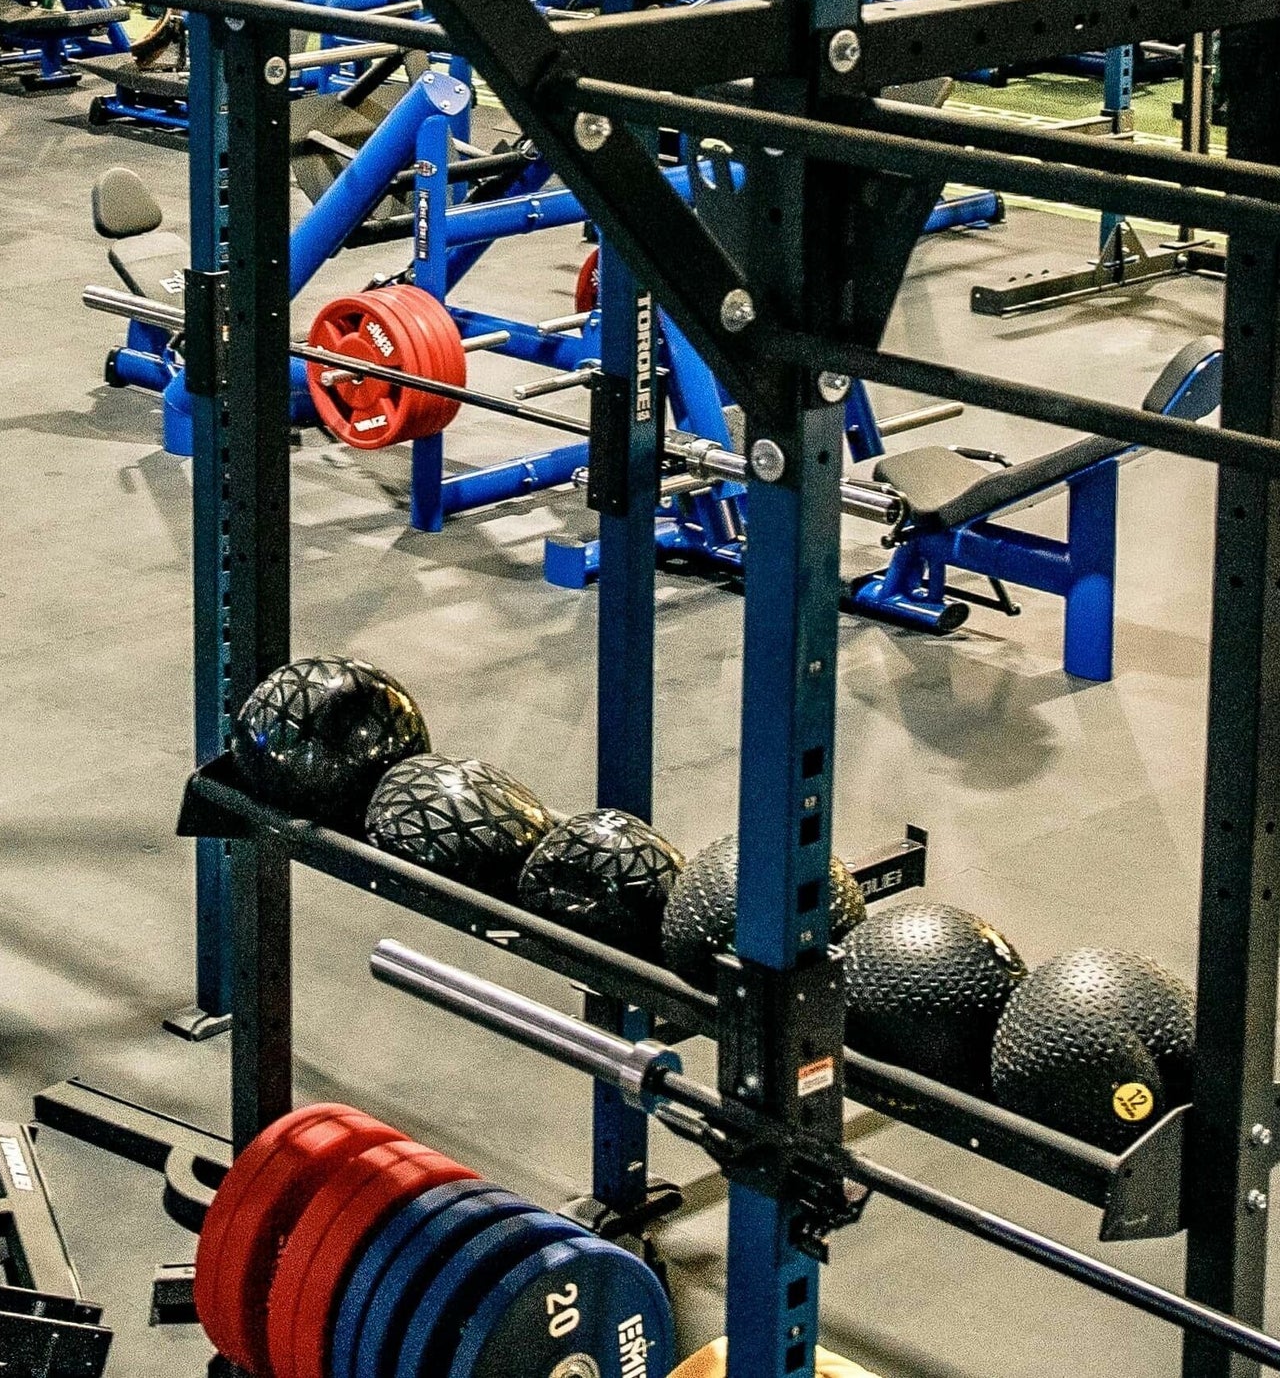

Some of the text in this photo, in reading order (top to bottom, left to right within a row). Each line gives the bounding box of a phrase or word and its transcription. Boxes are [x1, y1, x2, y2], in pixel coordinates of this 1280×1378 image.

[636, 291, 652, 411] TORQUE
[546, 1282, 581, 1338] 20
[617, 1313, 657, 1378] EM
